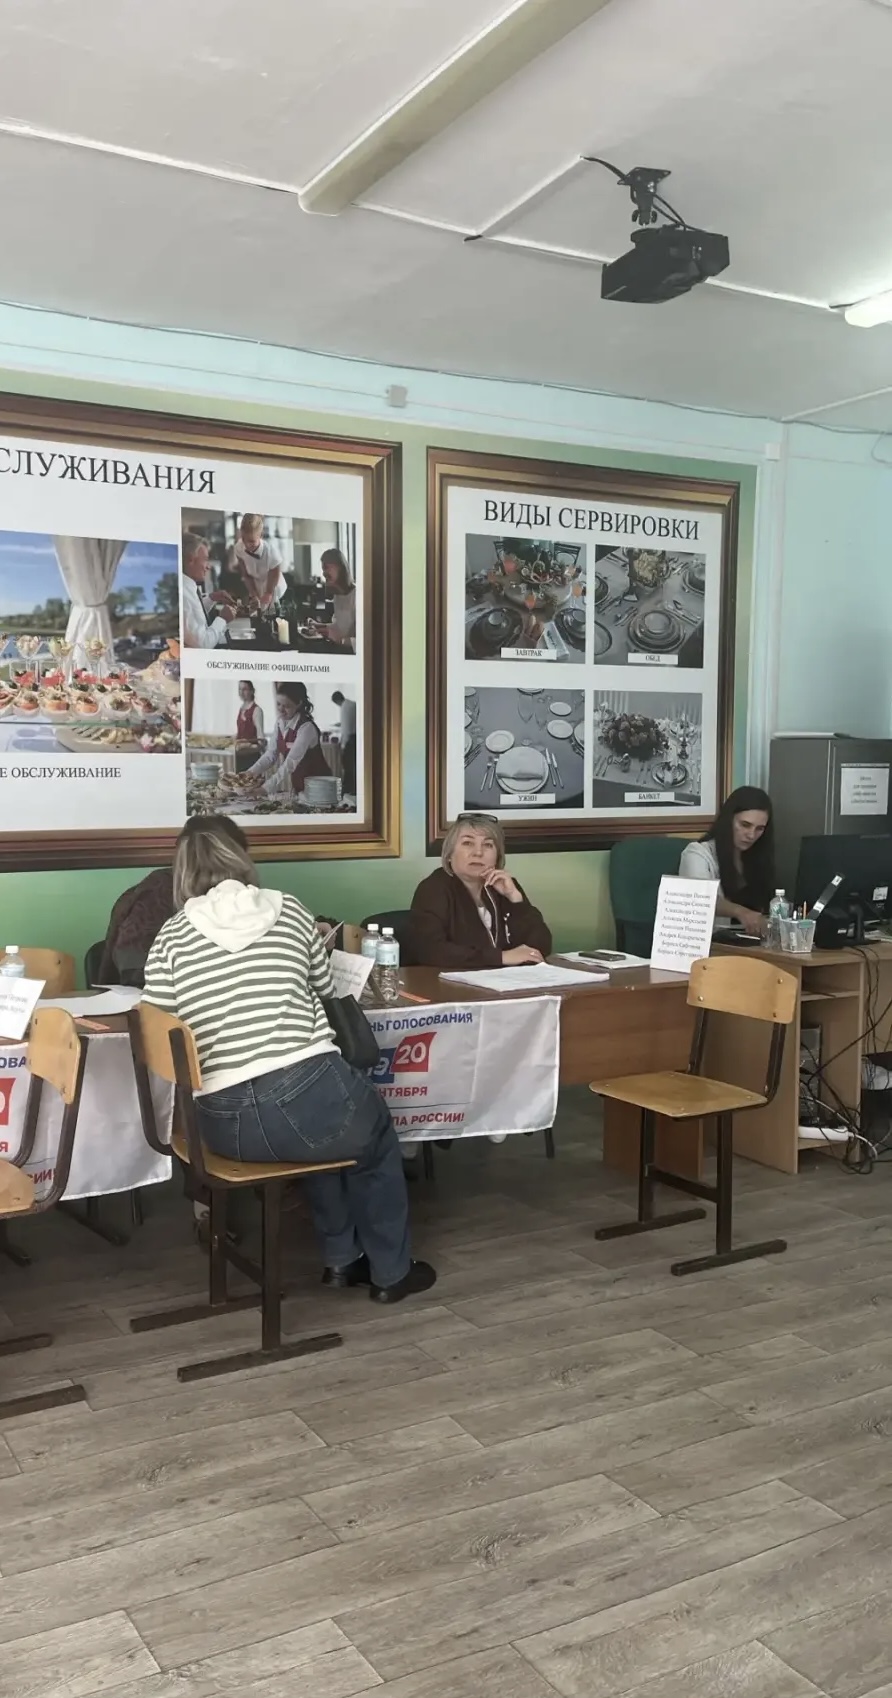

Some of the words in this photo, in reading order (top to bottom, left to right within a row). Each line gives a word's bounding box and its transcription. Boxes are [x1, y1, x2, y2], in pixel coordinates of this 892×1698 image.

[484, 500, 551, 530] ВИДЫ
[558, 507, 700, 540] СЕРВИРОВКИ
[207, 661, 269, 671] ОБСЛУЖИВАНИЕ
[271, 663, 330, 673] ОФИЦИАНТАМИ
[11, 767, 121, 778] ОБСЛУЖИВАНИЕ
[386, 1012, 473, 1031] ГОЛОСОВАНИЯ
[395, 1042, 426, 1065] 20
[411, 1112, 465, 1125] РОССИИ!
